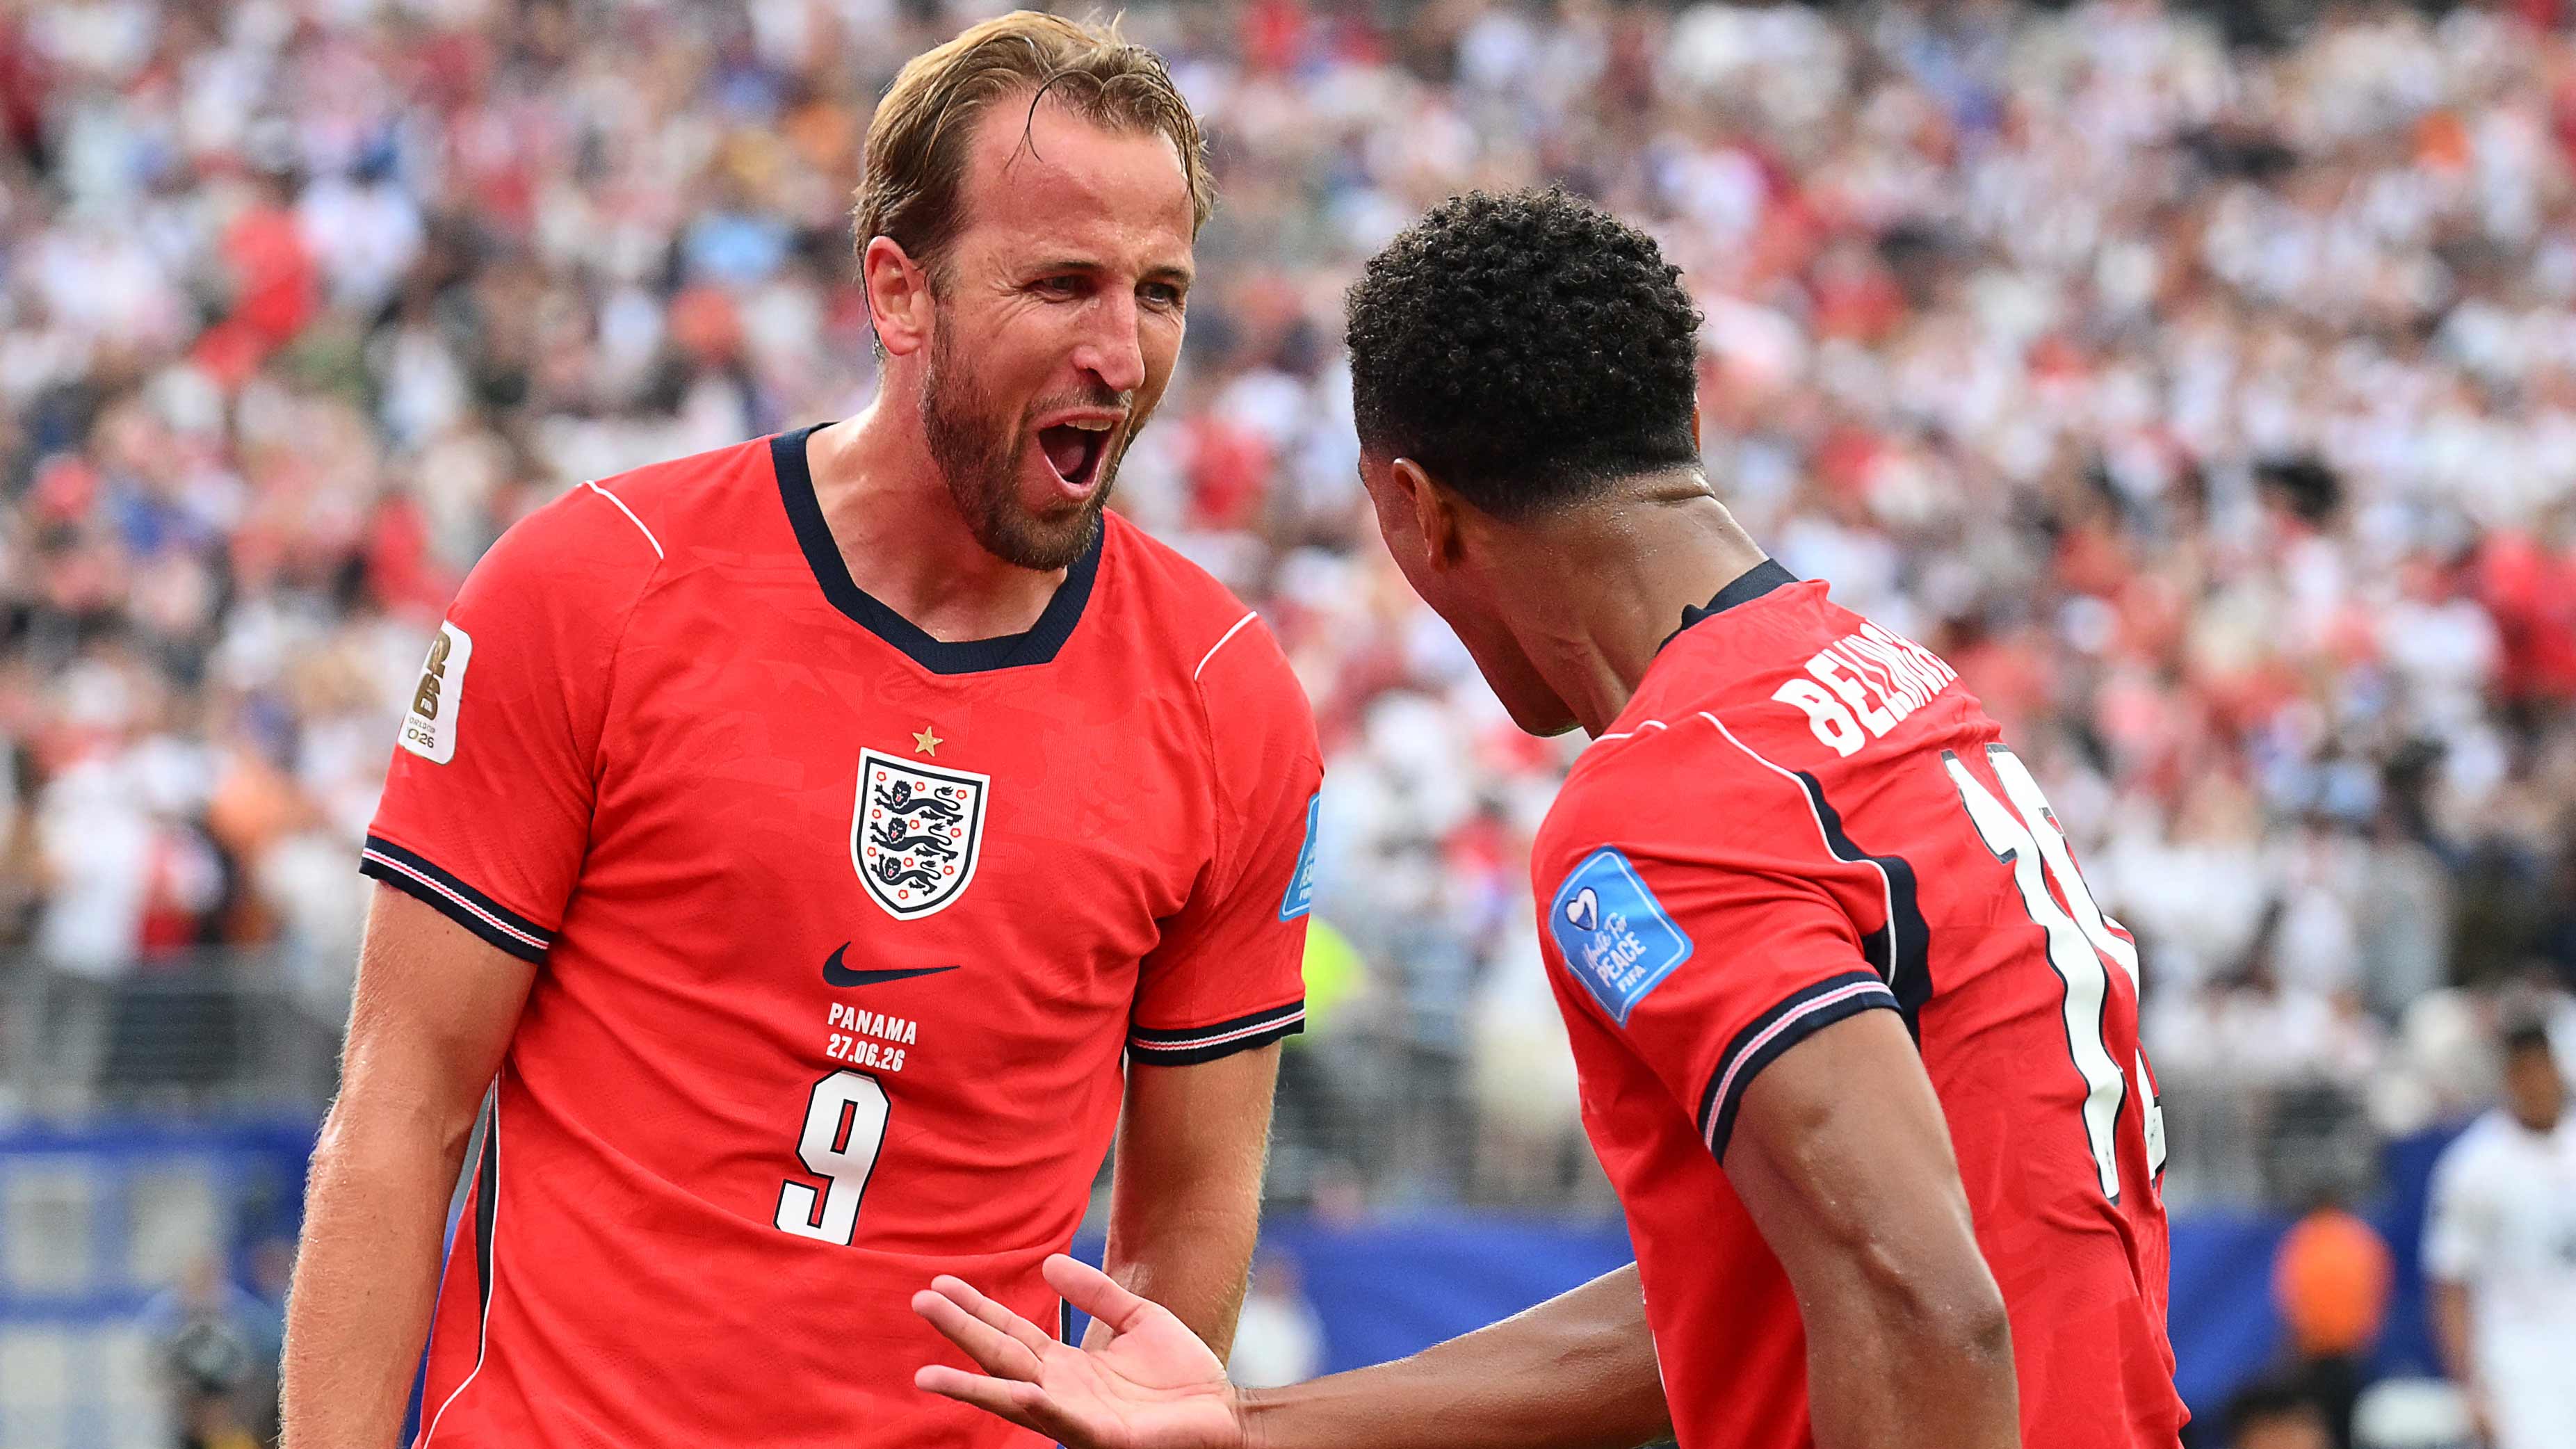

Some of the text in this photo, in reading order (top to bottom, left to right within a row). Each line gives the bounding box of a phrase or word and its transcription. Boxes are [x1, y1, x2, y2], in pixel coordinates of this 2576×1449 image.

[1769, 617, 1959, 758] BELLINGH
[407, 728, 435, 749] 026
[410, 717, 427, 729] ORLD
[1596, 931, 1647, 989] PEACE
[1616, 964, 1646, 993] FIFA
[827, 1002, 917, 1045] PANAMA
[826, 1033, 906, 1072] 27.06.26
[772, 1065, 891, 1247] 9
